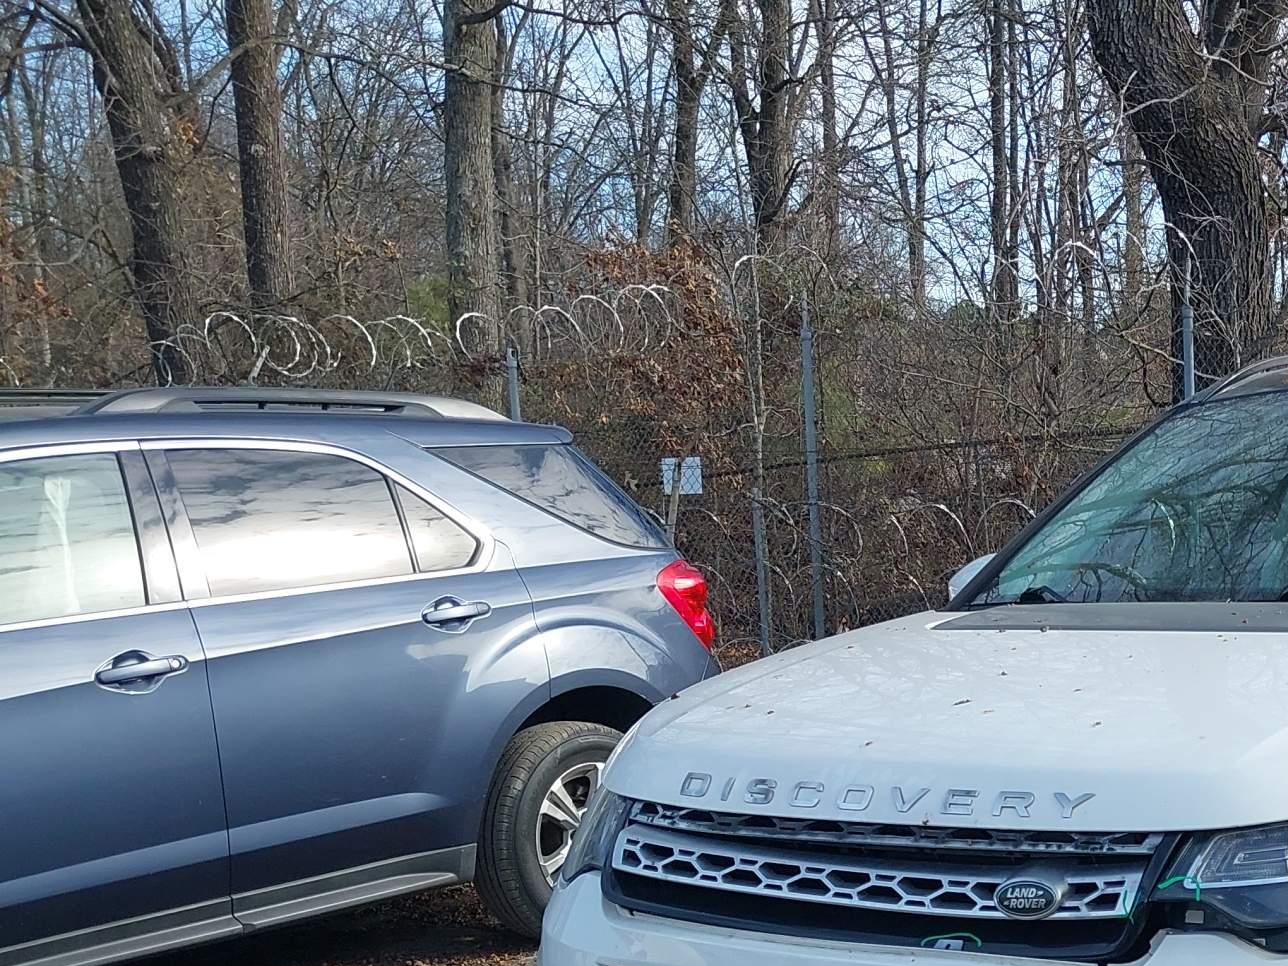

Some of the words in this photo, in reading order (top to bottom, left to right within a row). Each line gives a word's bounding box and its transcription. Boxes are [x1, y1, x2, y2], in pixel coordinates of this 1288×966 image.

[680, 772, 1097, 818] DISCOVERY
[1006, 887, 1037, 898] LAND
[1009, 898, 1046, 909] ROVER
